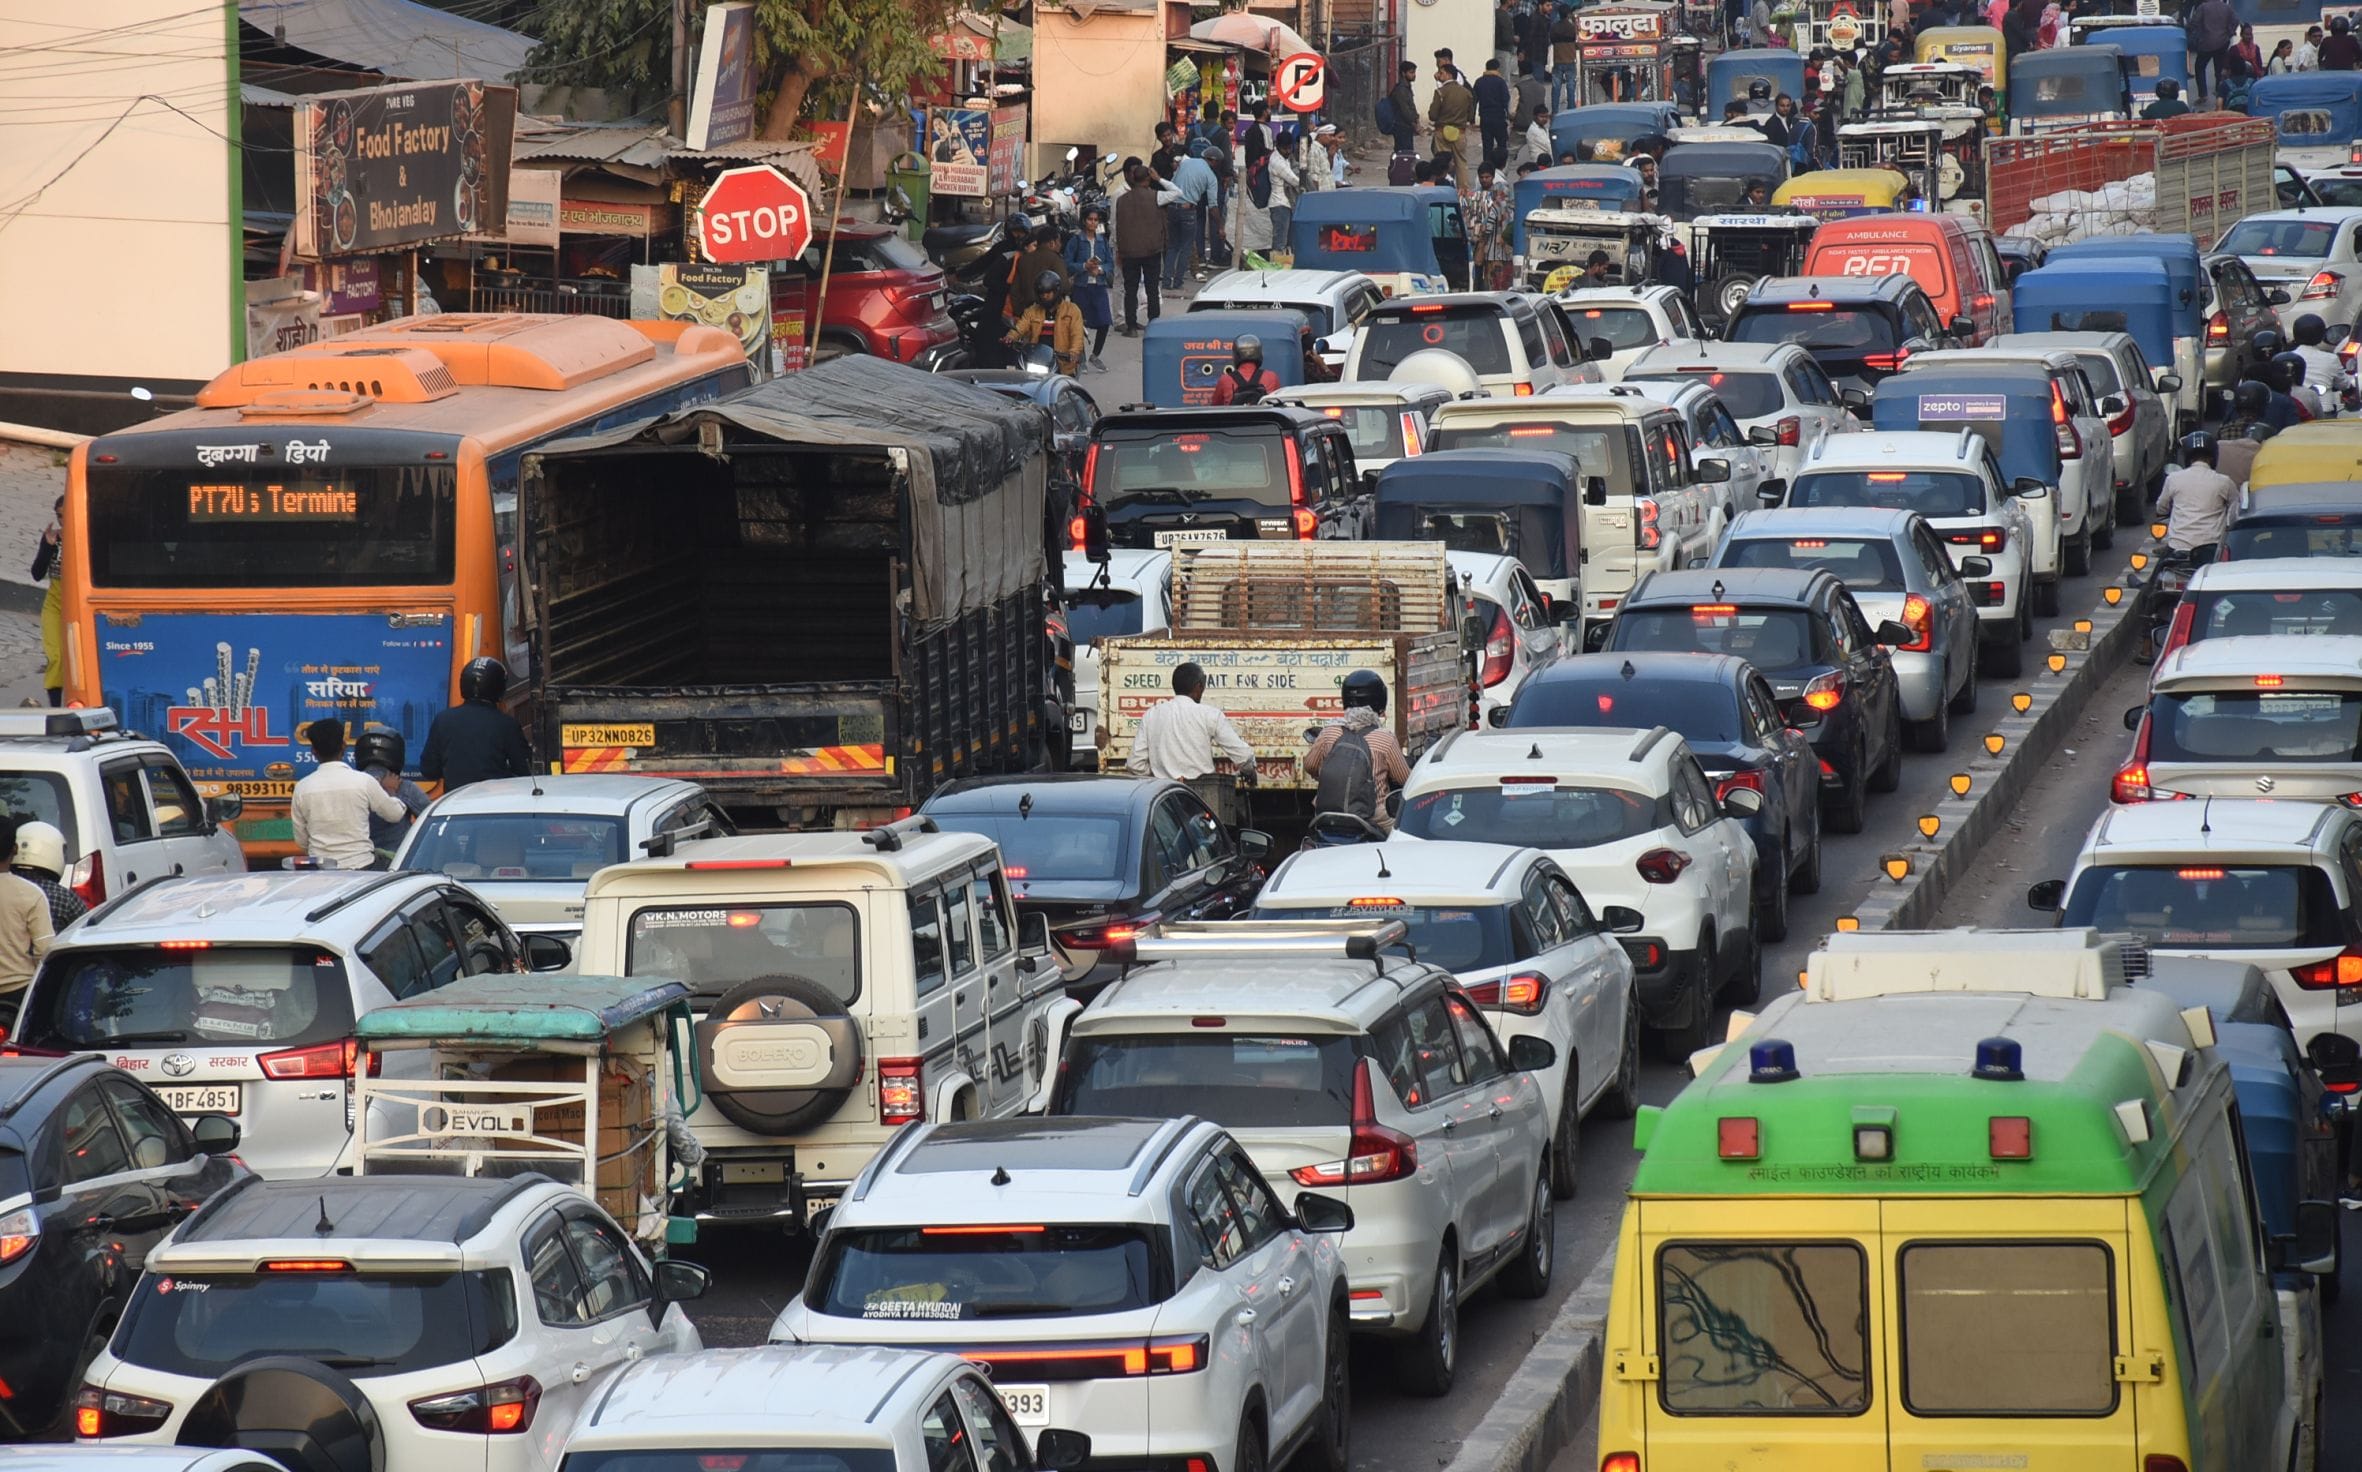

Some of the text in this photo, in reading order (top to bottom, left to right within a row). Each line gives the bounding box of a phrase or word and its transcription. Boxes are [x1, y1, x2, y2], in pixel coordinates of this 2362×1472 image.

[1294, 64, 1320, 99] P
[402, 94, 415, 108] VEG
[356, 122, 450, 159] Food Factory
[399, 165, 407, 187] &
[369, 195, 437, 231] Bhojanalay
[590, 209, 643, 227] भोजनालय
[711, 205, 798, 245] STOP
[1847, 231, 1909, 240] AMBULANCE
[352, 260, 370, 274] FOOD
[681, 273, 742, 286] Food Factory
[346, 280, 377, 299] FACTORY
[1183, 341, 1205, 351] जय
[1206, 338, 1221, 351] श्री
[1923, 401, 1961, 417] zepto
[196, 438, 331, 468] दुबग्गा डिपो
[106, 641, 155, 651] Since 1955
[305, 677, 369, 697] सरिया
[1123, 673, 1162, 689] SPEED
[1236, 674, 1259, 688] FOR
[1267, 674, 1297, 688] SIDE
[167, 706, 290, 759] RHL
[572, 730, 652, 743] UP32NN0826
[680, 911, 727, 920] MOTORS
[737, 1048, 806, 1062] BOLERO
[117, 1056, 249, 1070] बिहार सरकार
[1899, 1162, 1942, 1183] राष्ट्रीय
[174, 1281, 211, 1293] Spinny
[863, 1311, 901, 1319] AYODHYA
[880, 1301, 962, 1314] GEETA HYUNDAI
